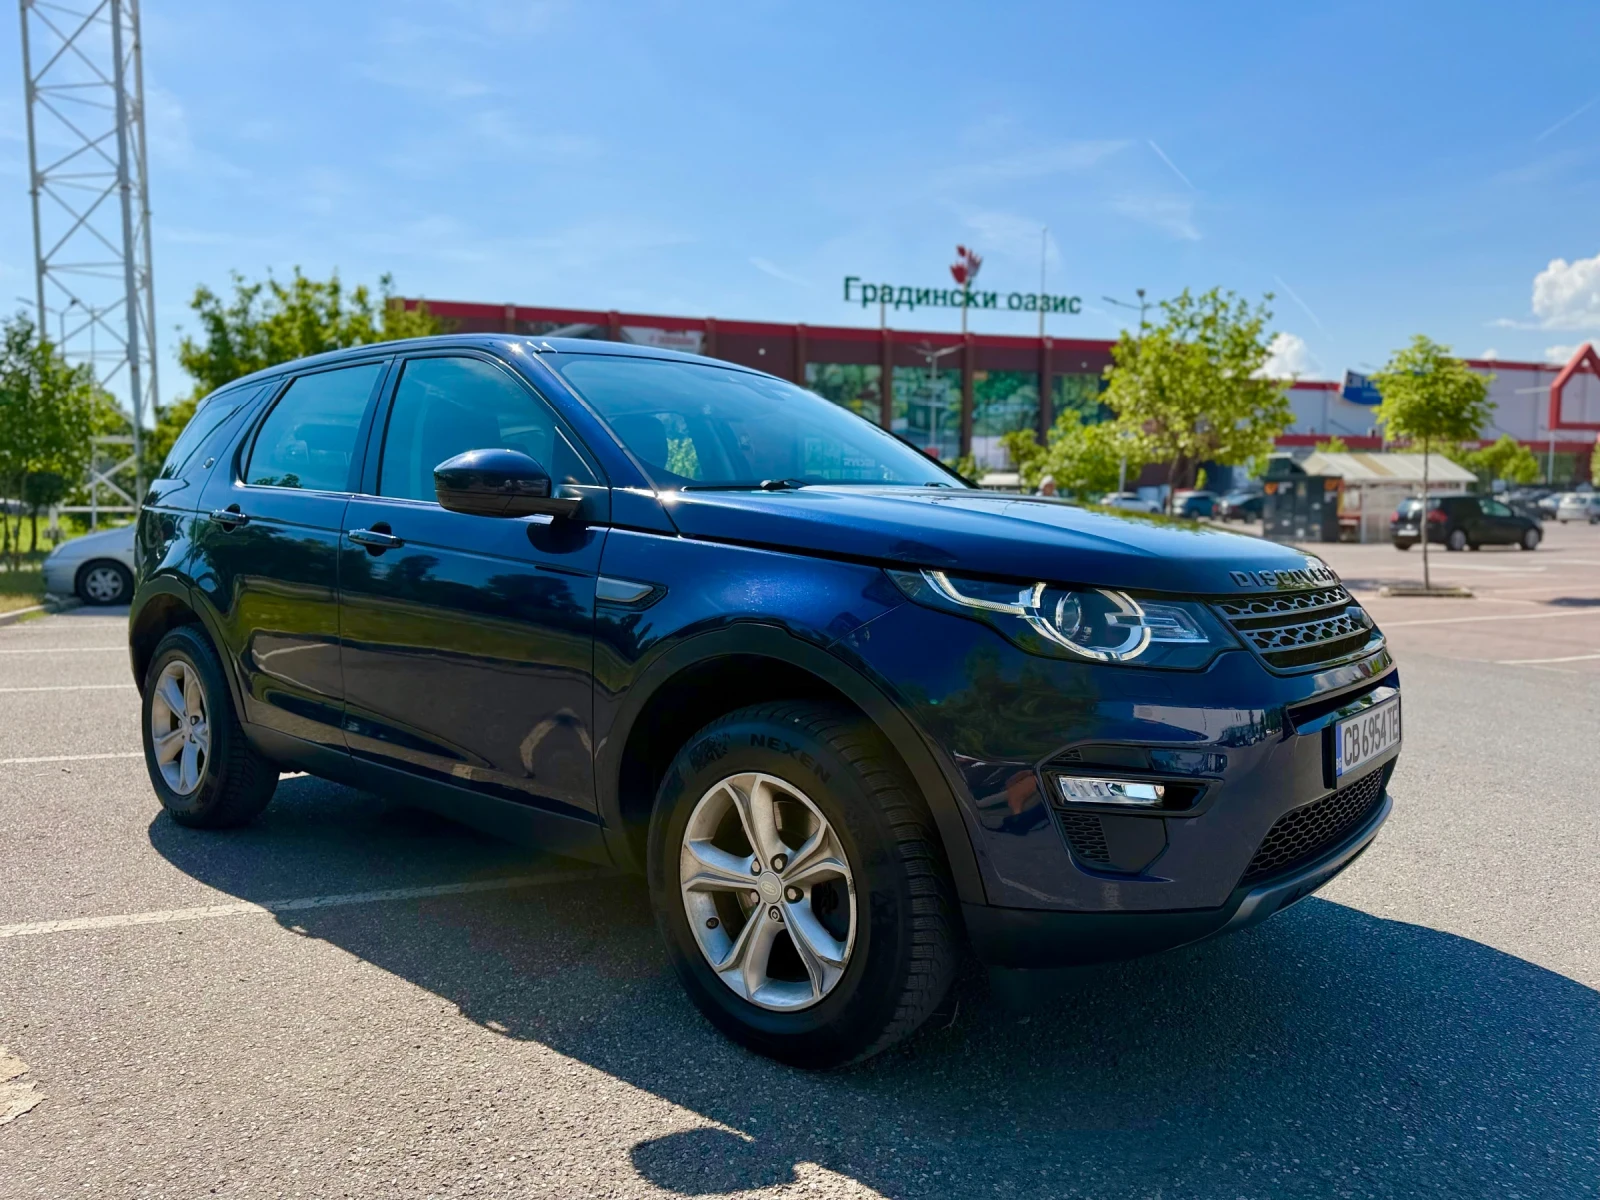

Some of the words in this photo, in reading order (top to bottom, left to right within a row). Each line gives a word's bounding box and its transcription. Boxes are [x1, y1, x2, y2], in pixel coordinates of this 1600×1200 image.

[844, 276, 997, 311] Градински
[1007, 291, 1082, 315] оазис
[750, 733, 831, 784] NEXEN
